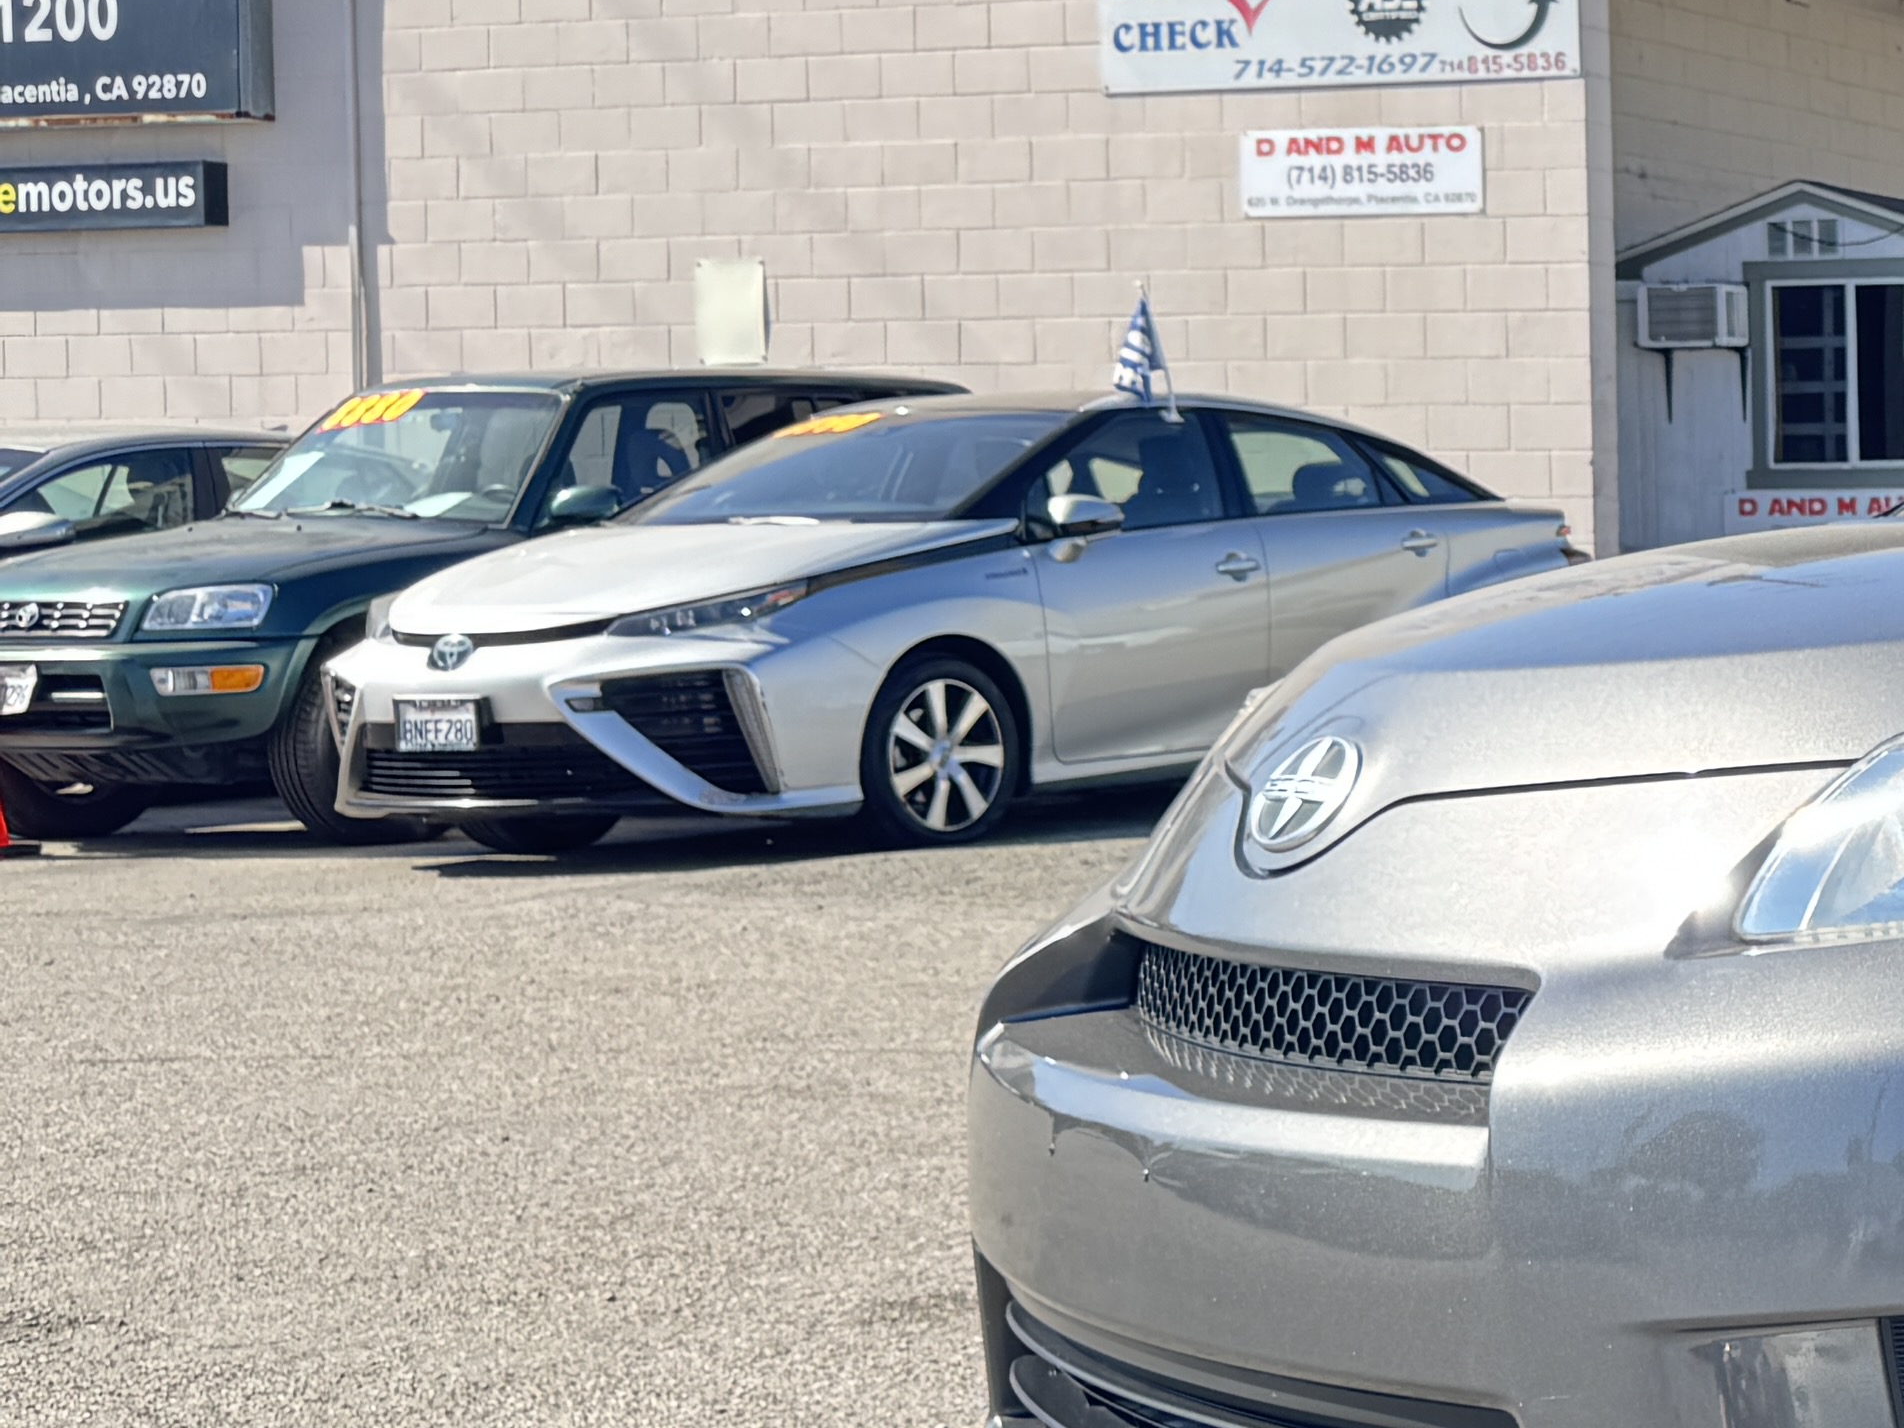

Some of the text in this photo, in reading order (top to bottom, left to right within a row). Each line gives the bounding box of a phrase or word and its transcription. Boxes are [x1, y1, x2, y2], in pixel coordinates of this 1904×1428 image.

[1112, 17, 1240, 55] CHECK
[1233, 52, 1438, 81] 714-572-1697
[95, 76, 129, 101] CA
[132, 73, 207, 100] 92870
[1255, 132, 1467, 158] D AND M AUTO
[1286, 162, 1435, 190] (714) 815-5836
[0, 173, 196, 214] emotors.us
[1737, 497, 1758, 518] D
[1767, 497, 1828, 517] AND
[1837, 496, 1857, 516] M
